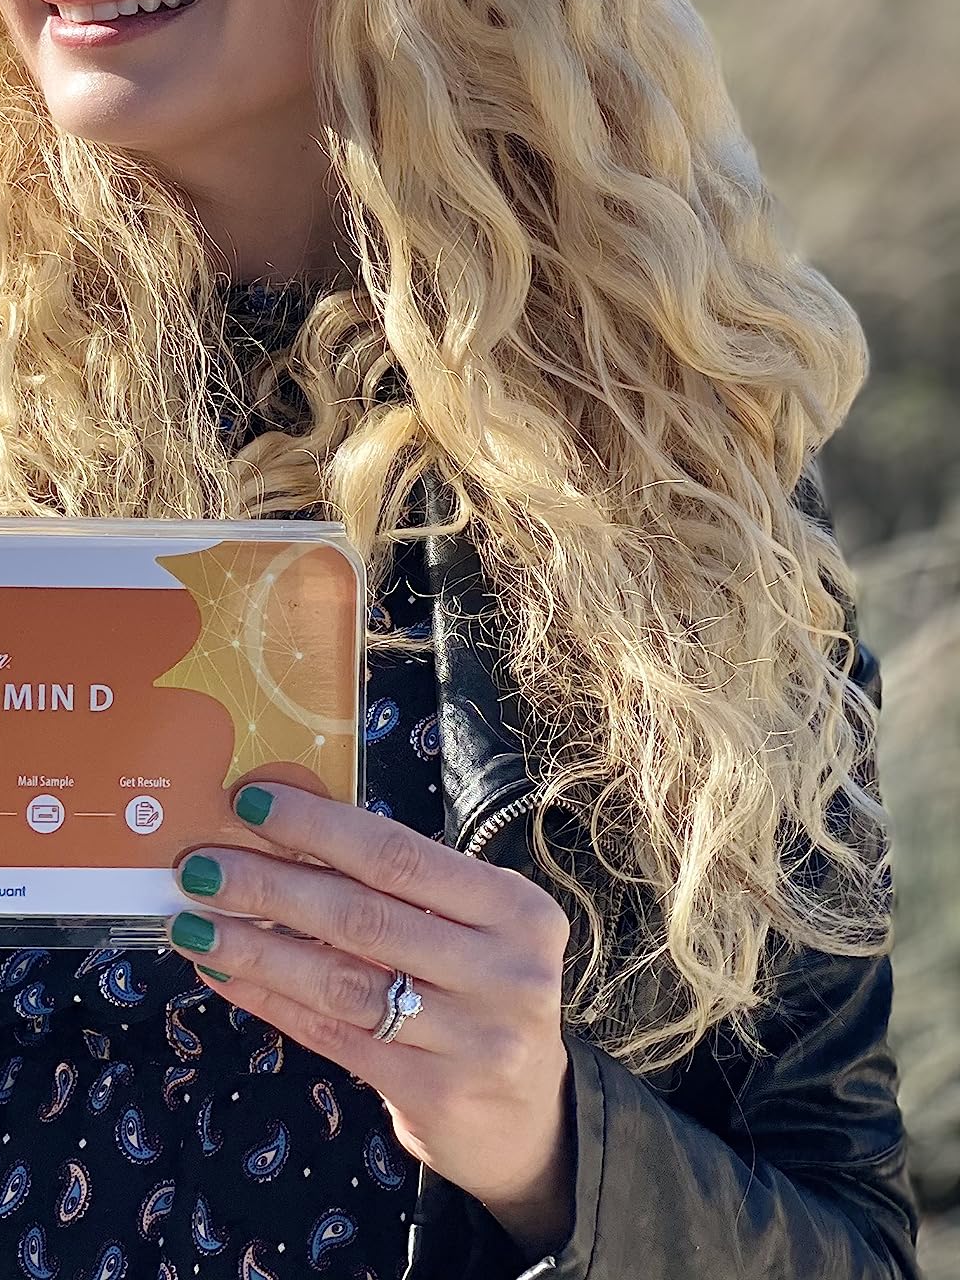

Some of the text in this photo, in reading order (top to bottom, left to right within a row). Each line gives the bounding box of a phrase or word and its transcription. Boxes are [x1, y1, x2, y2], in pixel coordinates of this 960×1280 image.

[89, 683, 114, 713] D
[18, 775, 75, 790] Mail Sample
[120, 776, 171, 788] Get Results
